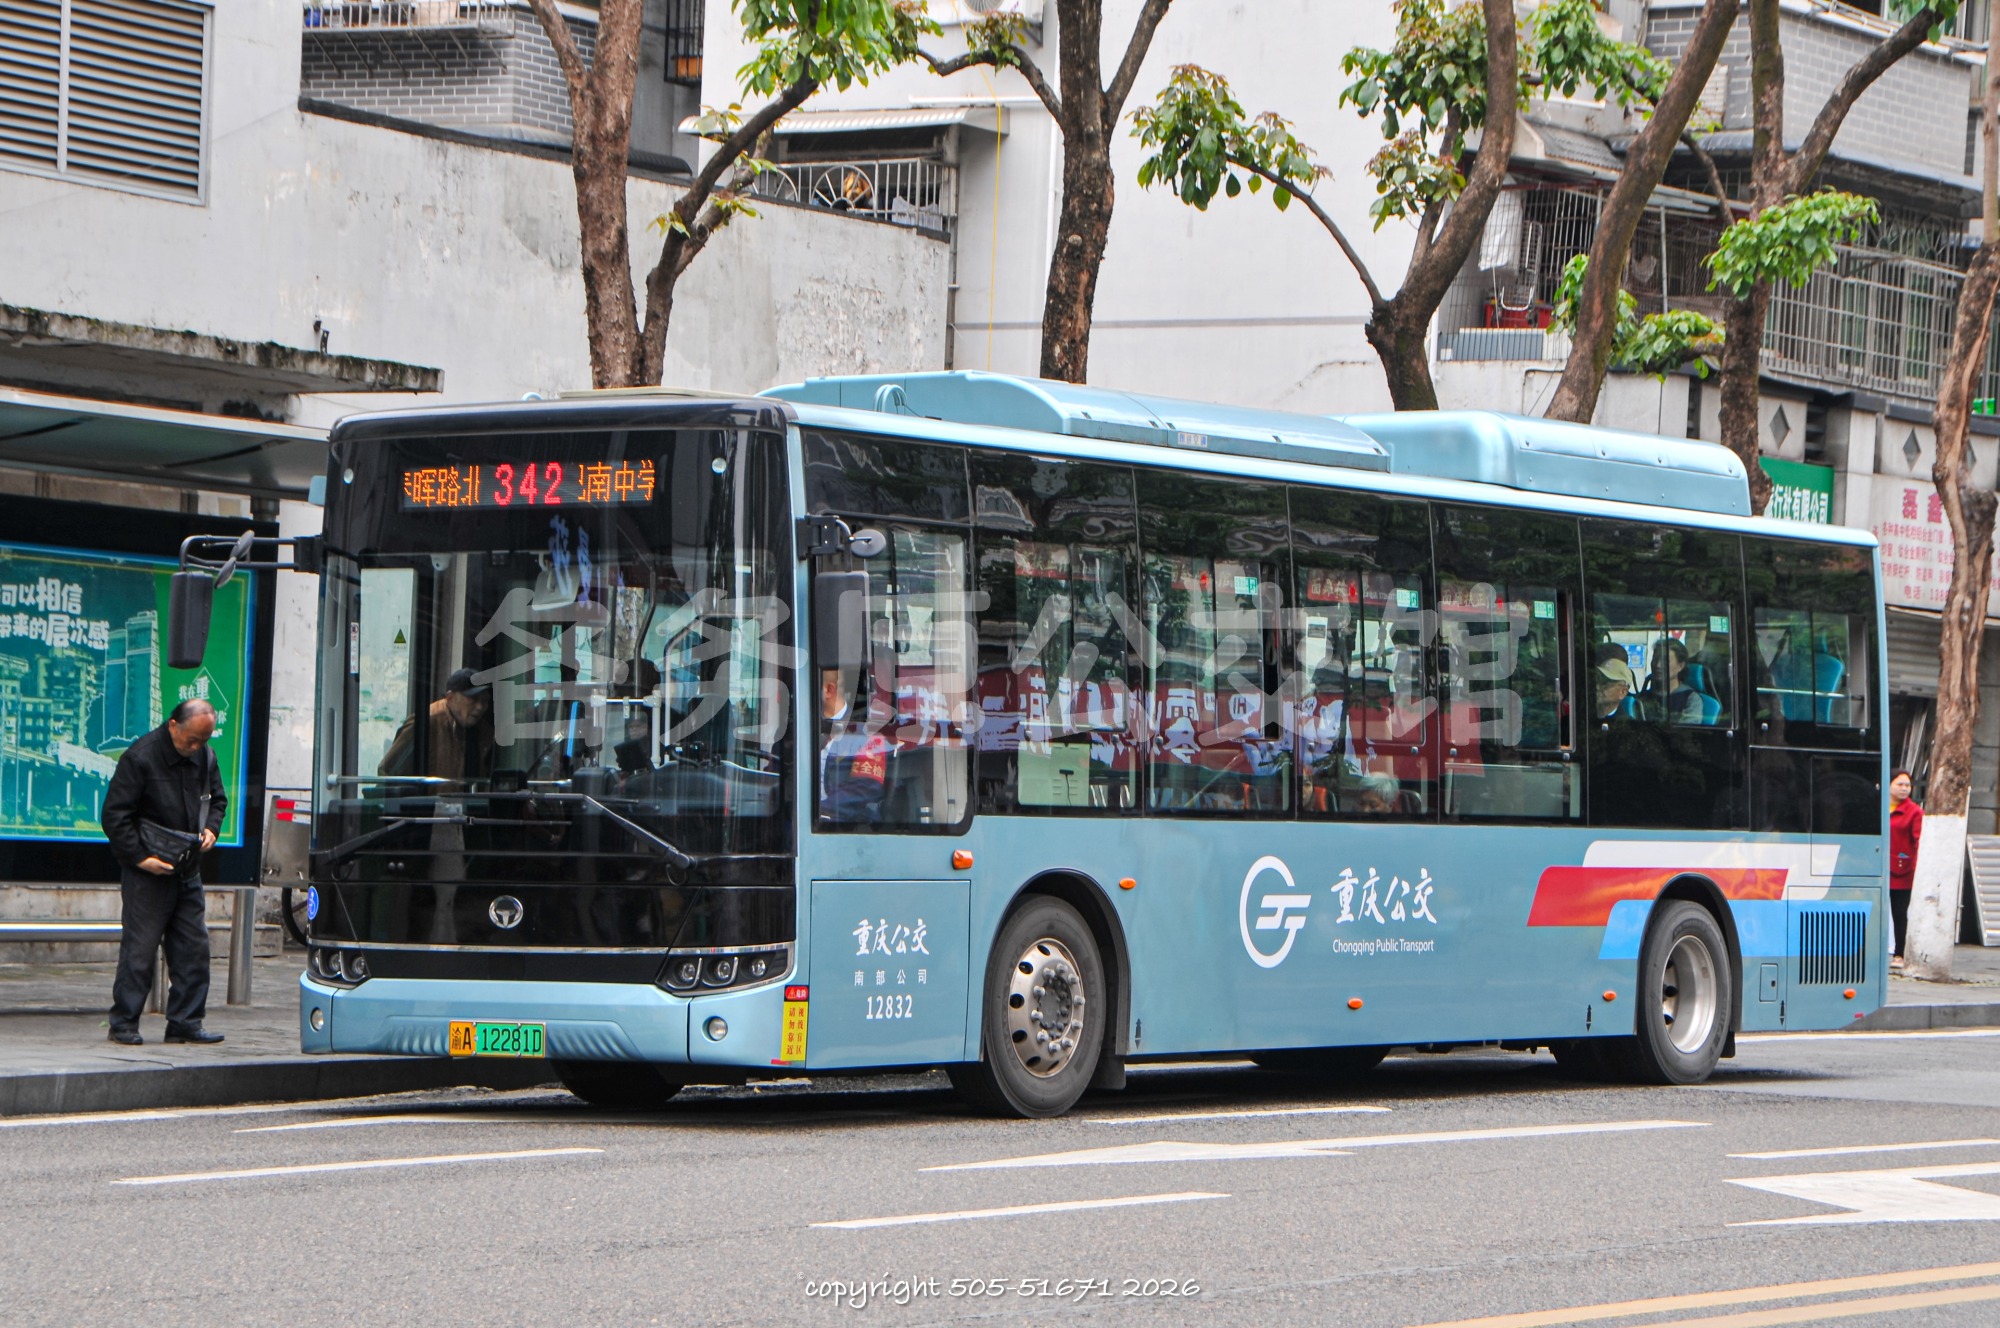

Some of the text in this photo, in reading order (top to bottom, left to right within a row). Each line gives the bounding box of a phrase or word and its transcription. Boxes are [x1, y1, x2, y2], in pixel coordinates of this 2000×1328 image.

[493, 462, 563, 507] 342
[1, 577, 83, 615] 可以相信
[0, 612, 110, 651] 带来的层次感
[1330, 866, 1438, 925] 重庆公交
[853, 918, 930, 956] 重庆公交
[1332, 938, 1435, 956] Chongqing Public Transport
[854, 968, 927, 987] 南部公司
[866, 994, 913, 1020] 12832
